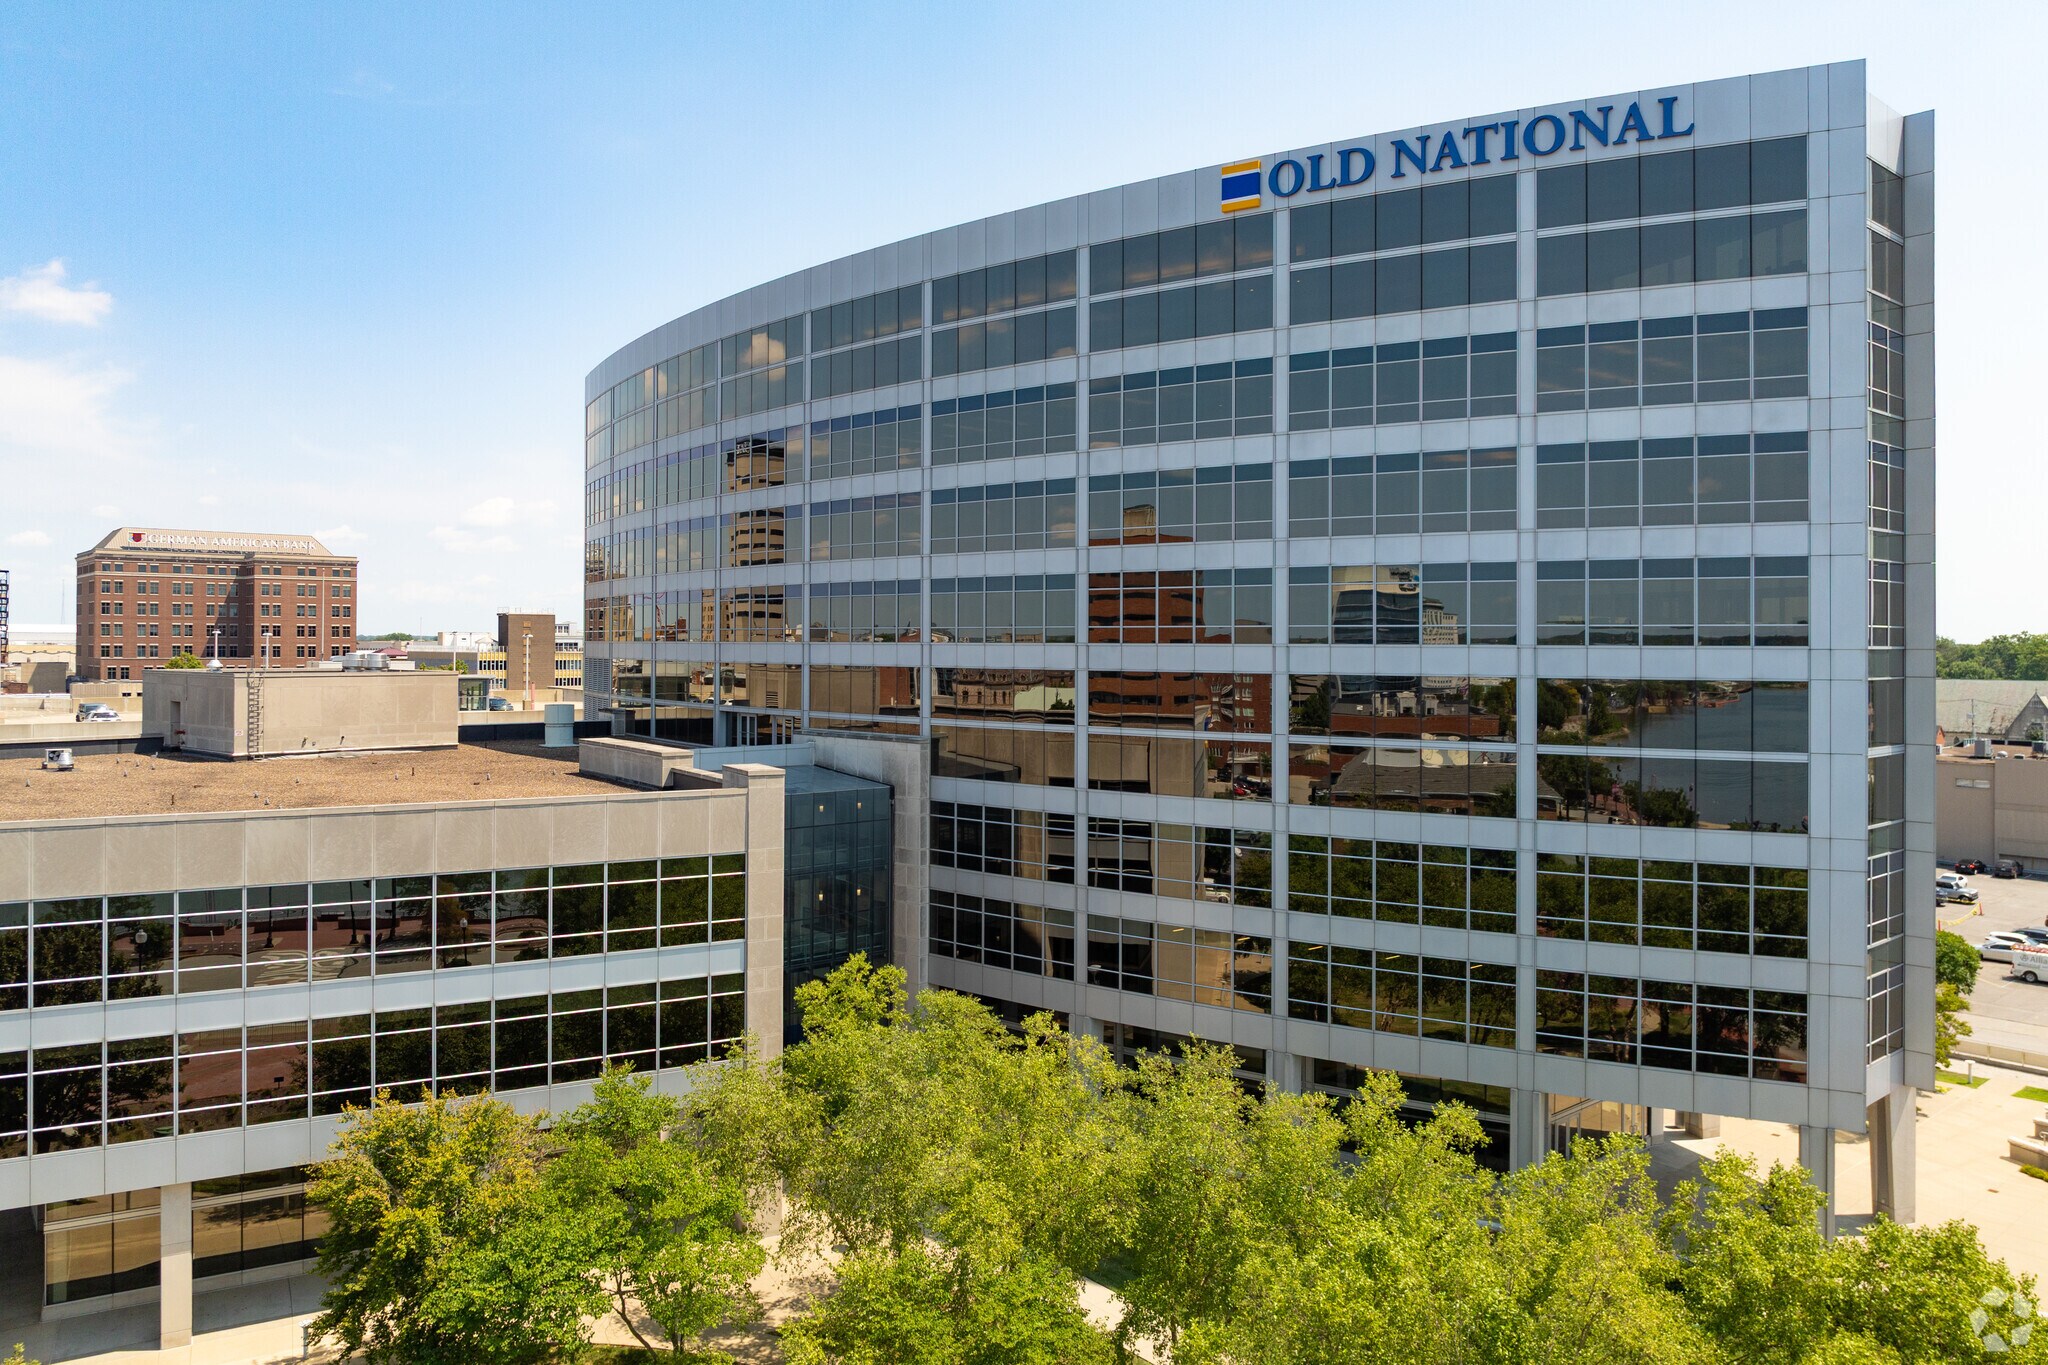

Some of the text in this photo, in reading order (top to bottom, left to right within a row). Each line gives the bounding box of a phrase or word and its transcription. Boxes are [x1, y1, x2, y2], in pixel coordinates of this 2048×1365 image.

[1268, 96, 1695, 198] OLD NATIONAL
[148, 533, 317, 550] GERMAN AMERICAN BANK
